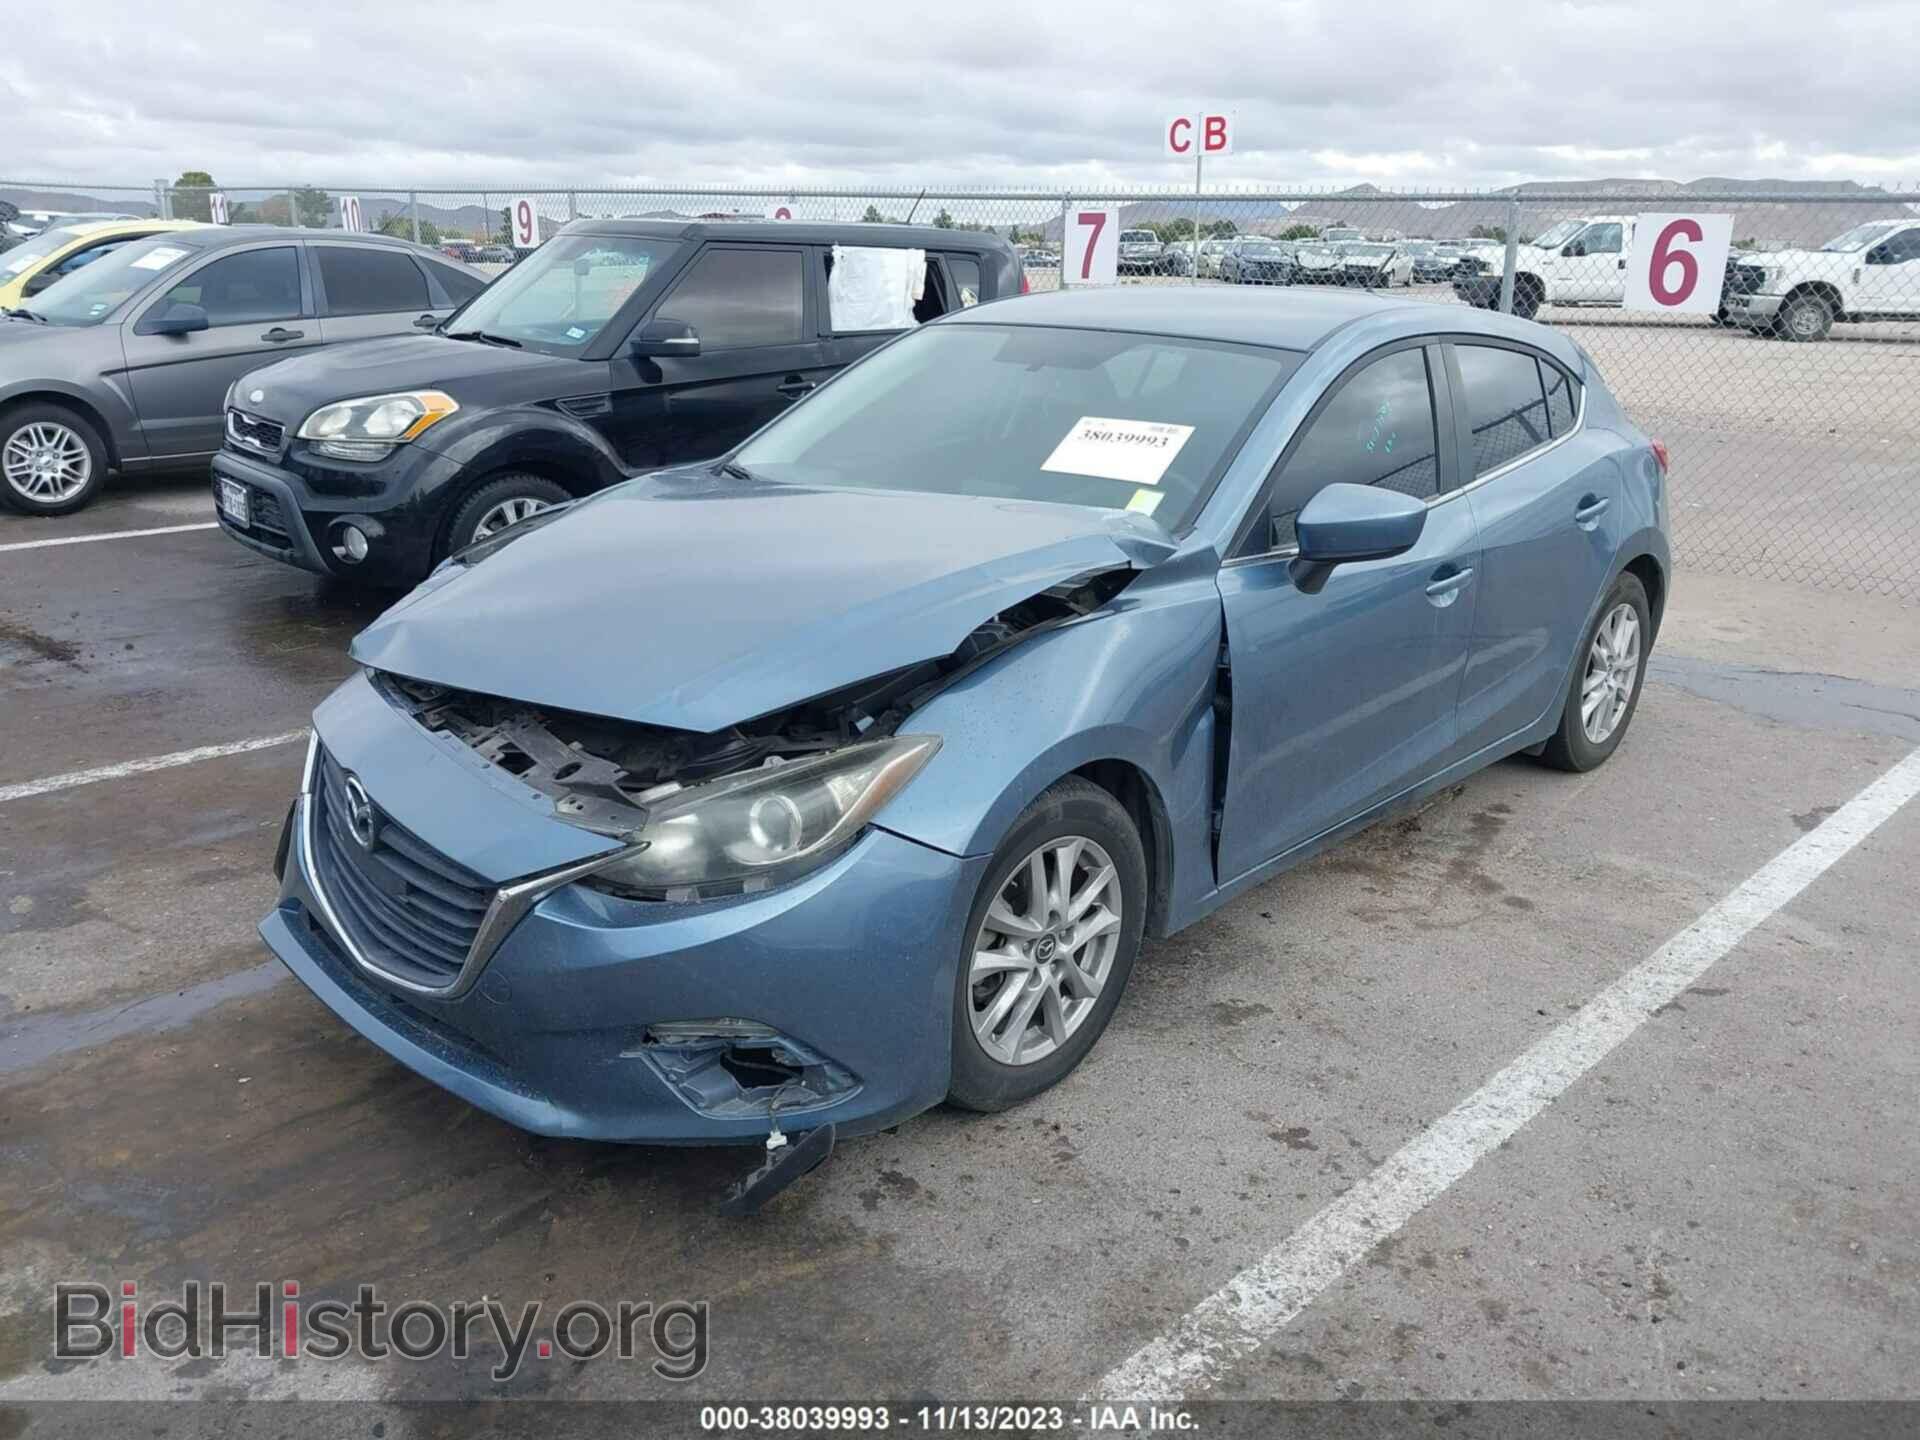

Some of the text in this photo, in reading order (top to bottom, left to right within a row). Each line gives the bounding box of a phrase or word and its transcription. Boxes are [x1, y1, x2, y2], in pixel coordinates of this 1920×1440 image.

[1170, 118, 1191, 153] C
[1205, 116, 1226, 151] B
[212, 195, 227, 224] 11
[343, 198, 360, 232] 10
[517, 199, 532, 246] 9
[1078, 213, 1106, 279] 7
[1649, 219, 1703, 306] 6
[1077, 429, 1168, 448] 38039993
